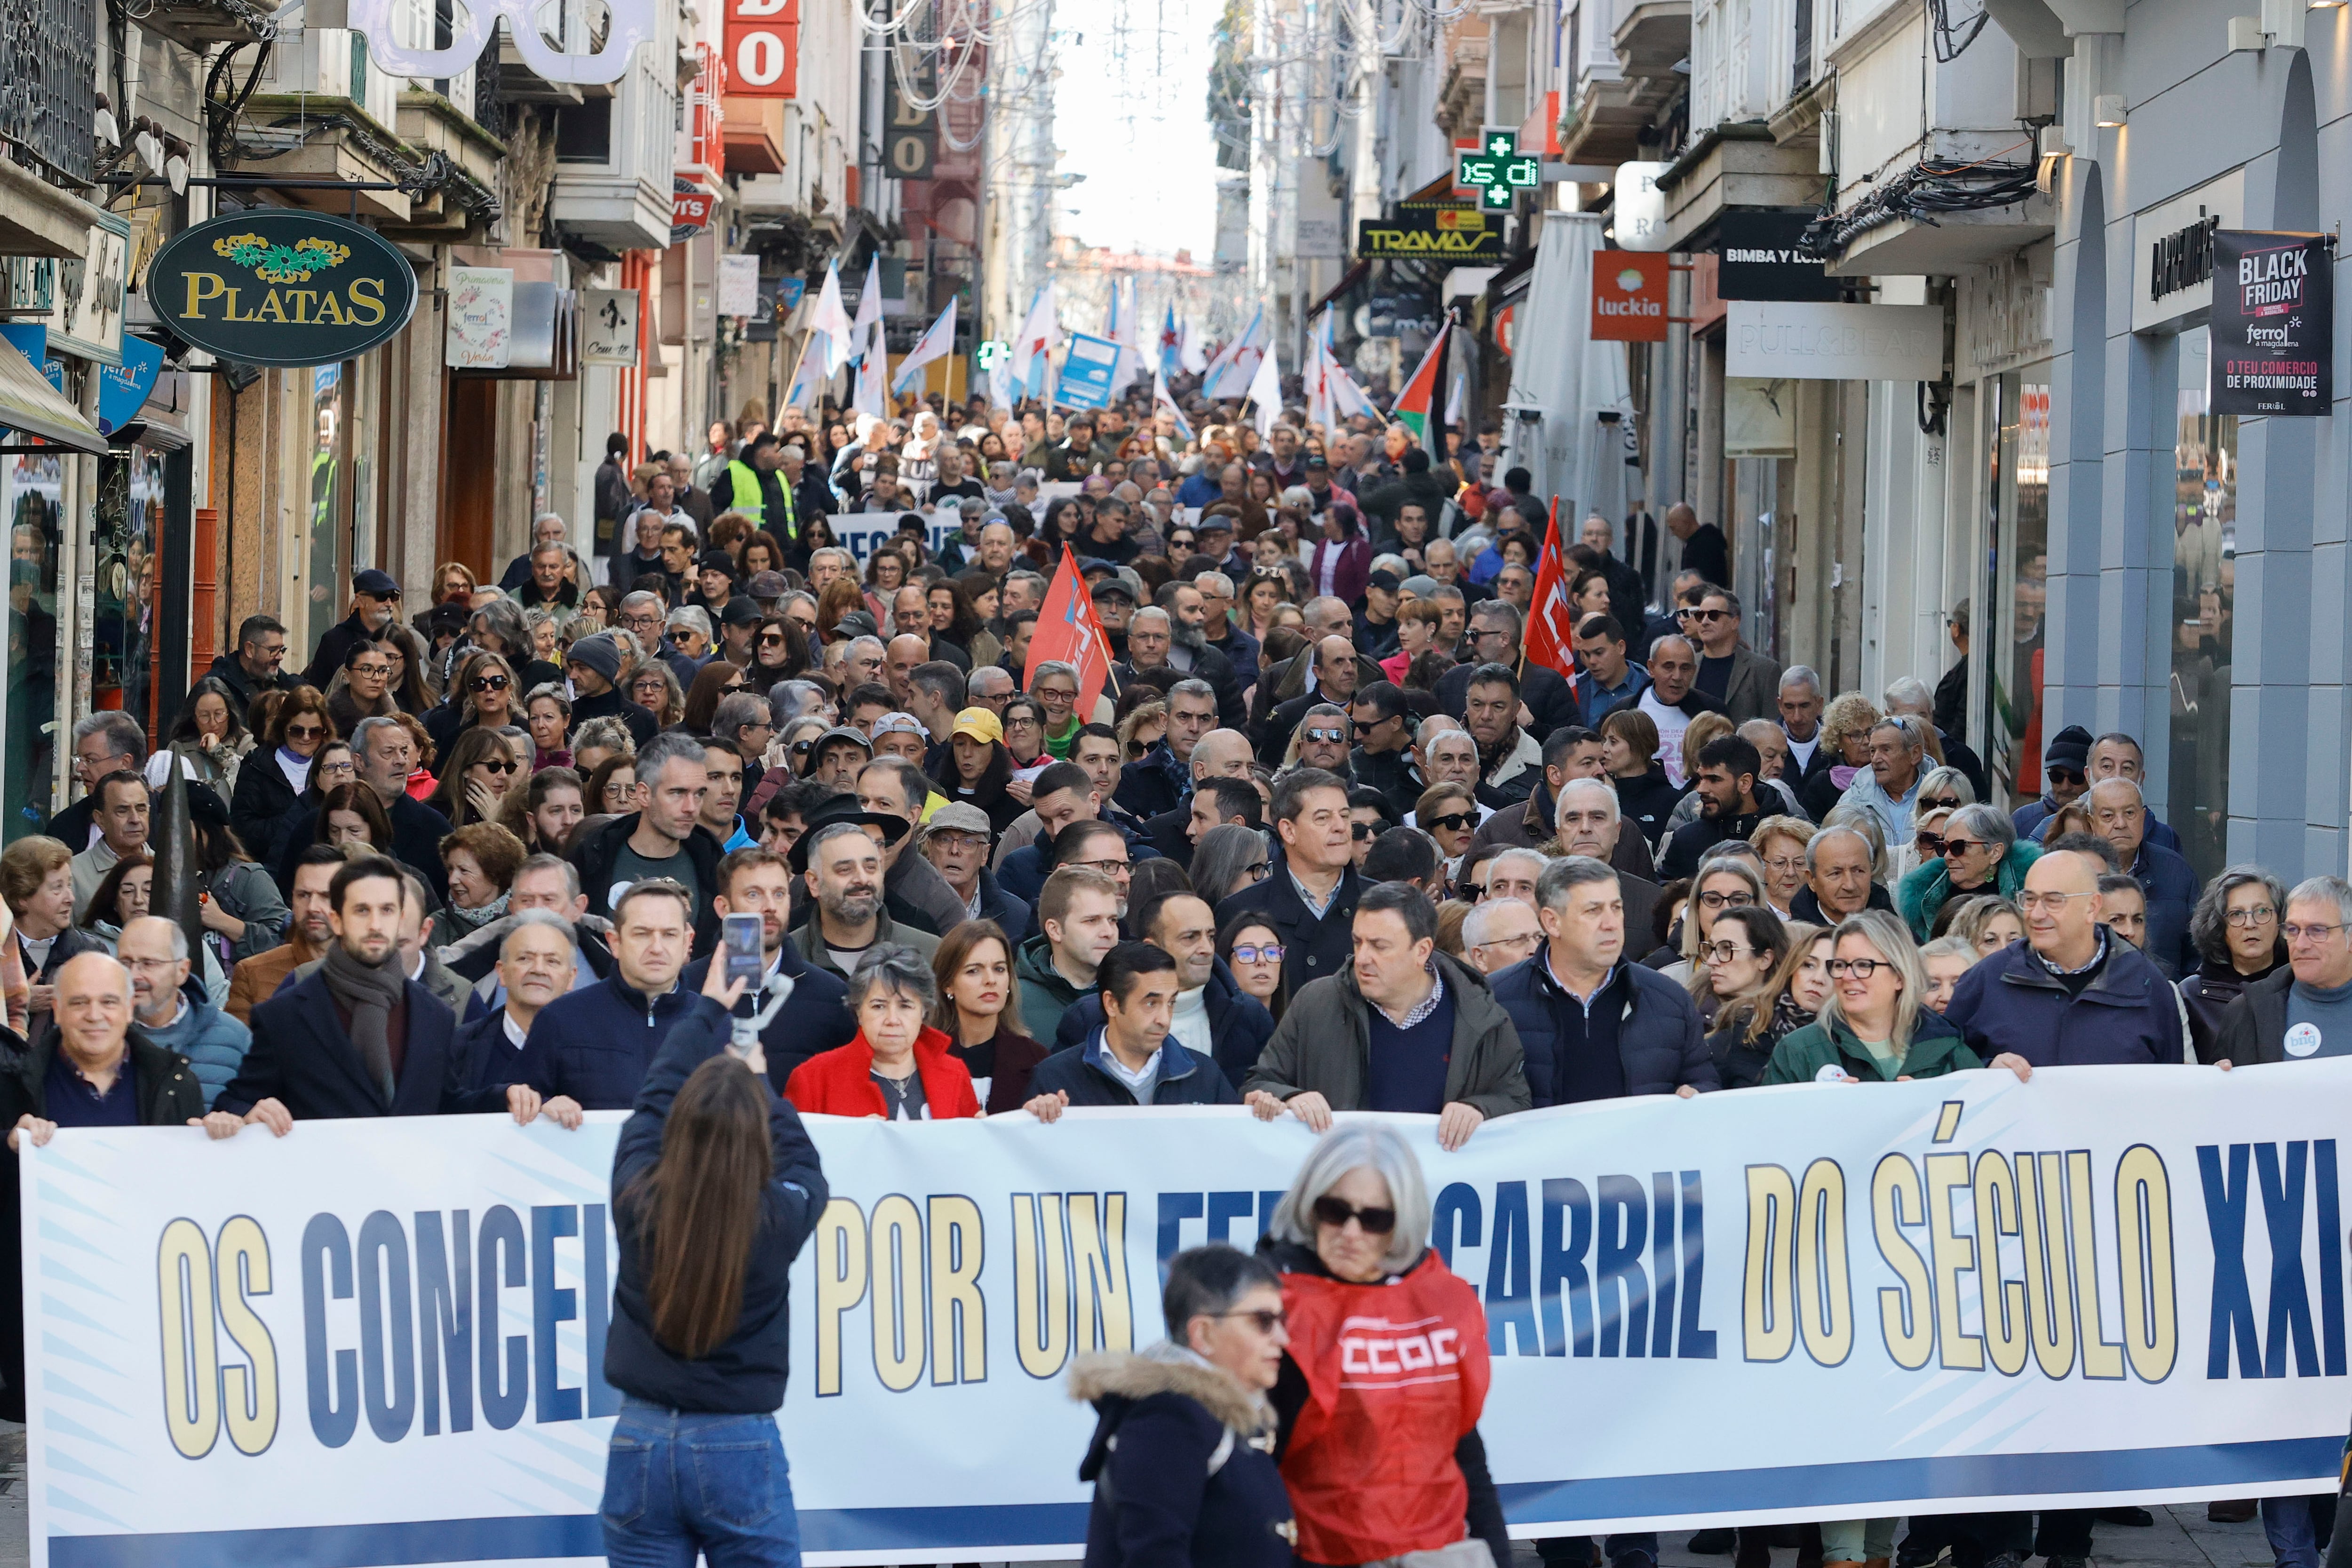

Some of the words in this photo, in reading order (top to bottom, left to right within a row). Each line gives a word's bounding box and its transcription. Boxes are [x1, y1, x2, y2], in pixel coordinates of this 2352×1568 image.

[1727, 248, 1777, 263] BIMBA
[1778, 250, 1790, 263] Y
[2239, 249, 2308, 285] BLACK
[180, 269, 386, 326] PLATAS
[2246, 278, 2301, 306] FRIDAY
[1598, 296, 1661, 316] luckia
[1740, 325, 1928, 356] PULL&BEAR
[2247, 324, 2288, 347] ferrol
[2227, 360, 2234, 374] O
[2238, 361, 2257, 374] TEU
[2261, 361, 2318, 374] COMERCIO
[2227, 375, 2241, 388] DE
[2243, 375, 2317, 389] PROXIMIDADE
[2289, 1035, 2316, 1047] bng
[157, 1214, 279, 1460] OS
[815, 1193, 988, 1398] POR
[1010, 1192, 1135, 1380] UN
[1742, 1157, 1855, 1368] DO
[1870, 1100, 2179, 1385] SÉCULO
[2195, 1138, 2348, 1380] XXI
